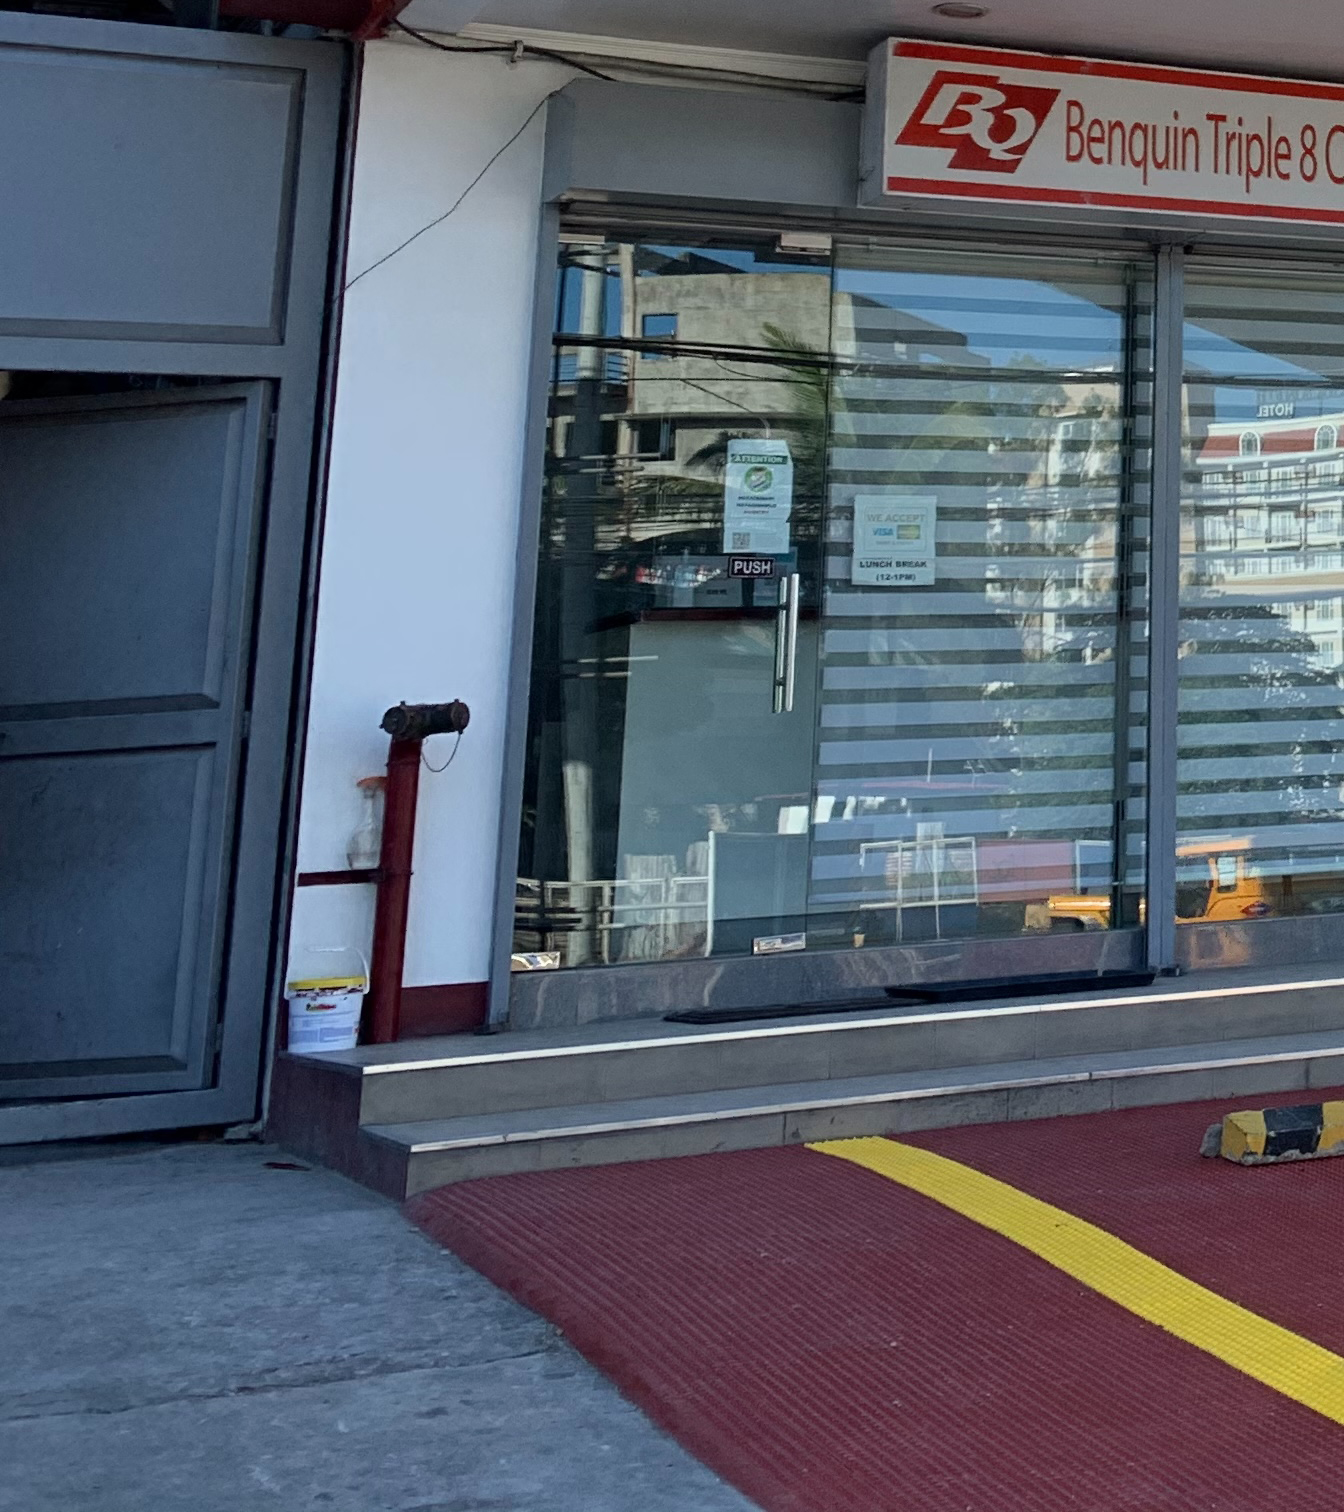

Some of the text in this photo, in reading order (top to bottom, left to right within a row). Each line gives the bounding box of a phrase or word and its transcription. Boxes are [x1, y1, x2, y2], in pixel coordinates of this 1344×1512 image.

[1064, 100, 1200, 186] Benquin
[1206, 112, 1291, 195] Triple
[1299, 124, 1318, 182] 8
[867, 513, 926, 523] WE ACCEPT
[872, 527, 894, 536] VISA
[733, 560, 771, 574] PUSH
[859, 560, 928, 568] LUNCH BREAK
